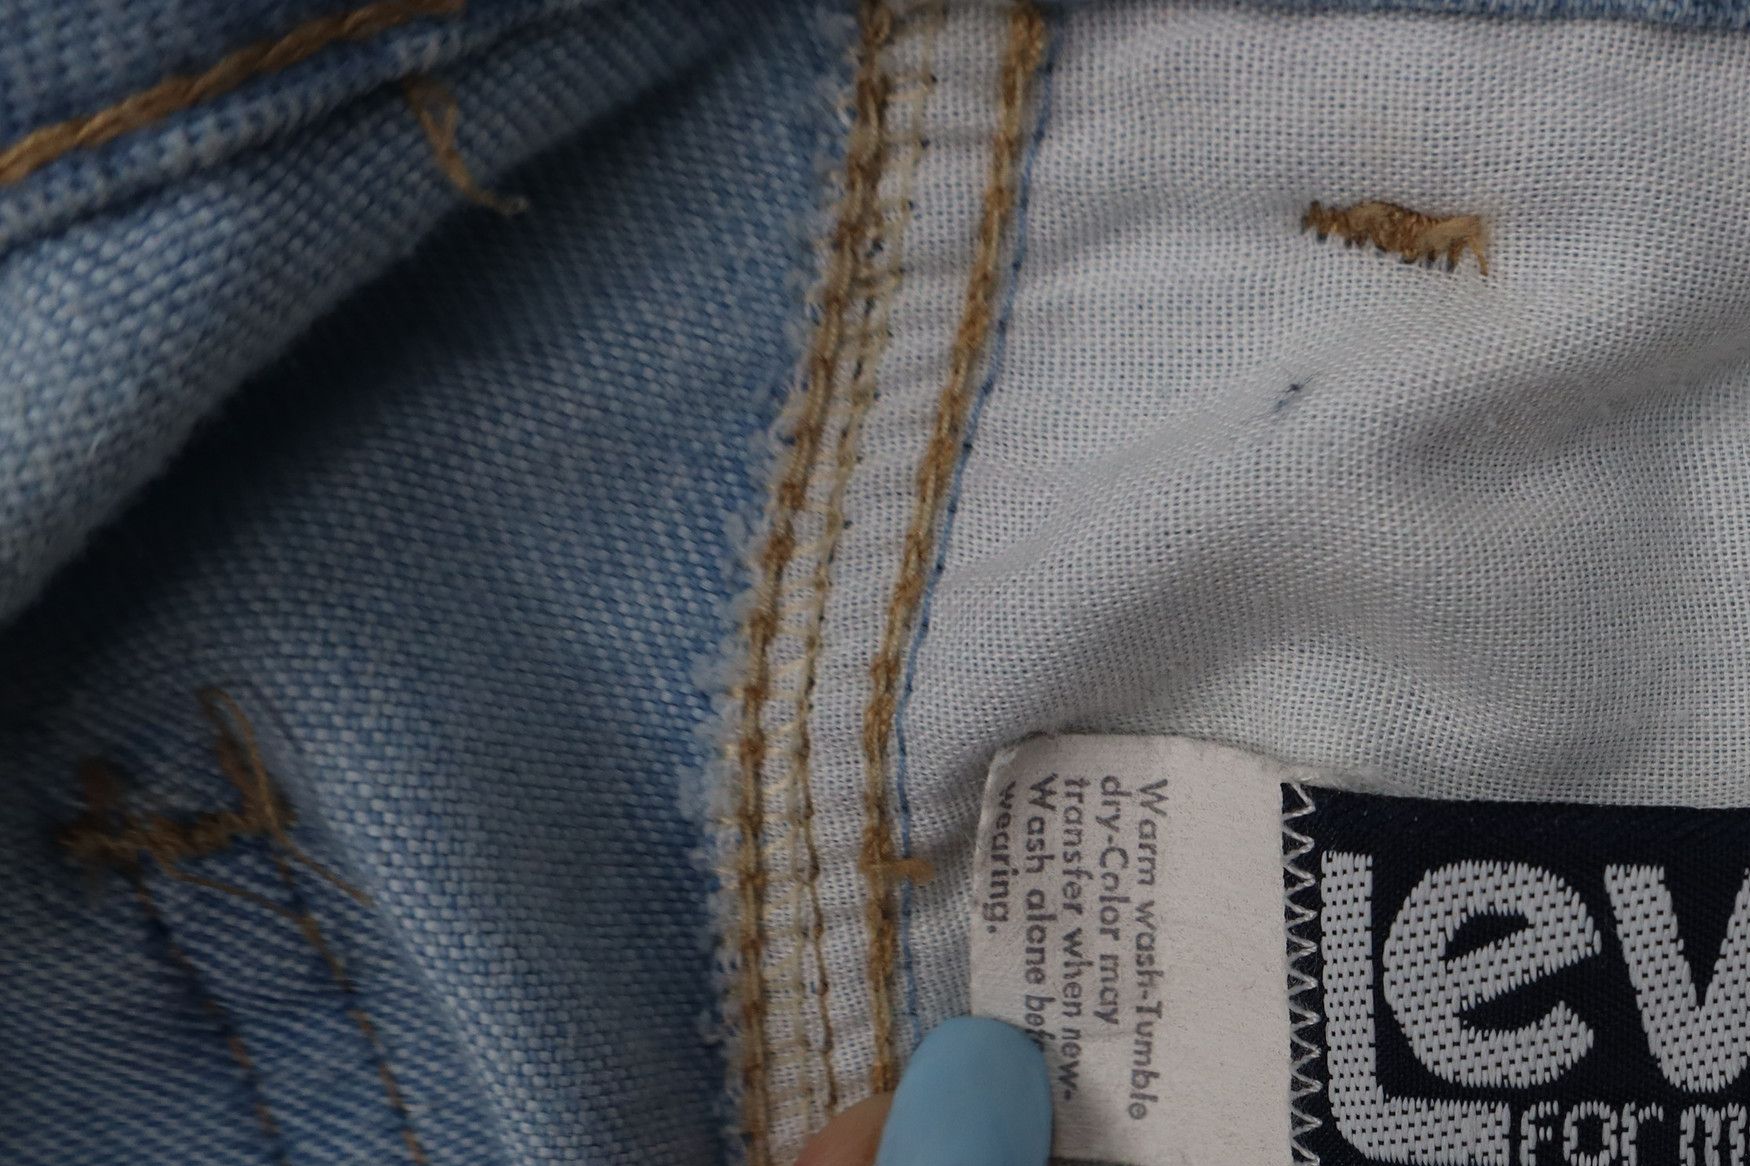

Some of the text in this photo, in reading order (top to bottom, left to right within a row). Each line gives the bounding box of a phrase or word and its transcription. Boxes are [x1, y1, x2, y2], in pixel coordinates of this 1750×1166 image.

[983, 780, 1019, 935] wearing.
[1024, 773, 1059, 1042] Wash alone bef
[1056, 776, 1093, 1101] transfer when new-
[1093, 774, 1132, 1026] dry-Color may
[1134, 778, 1169, 886] Warm
